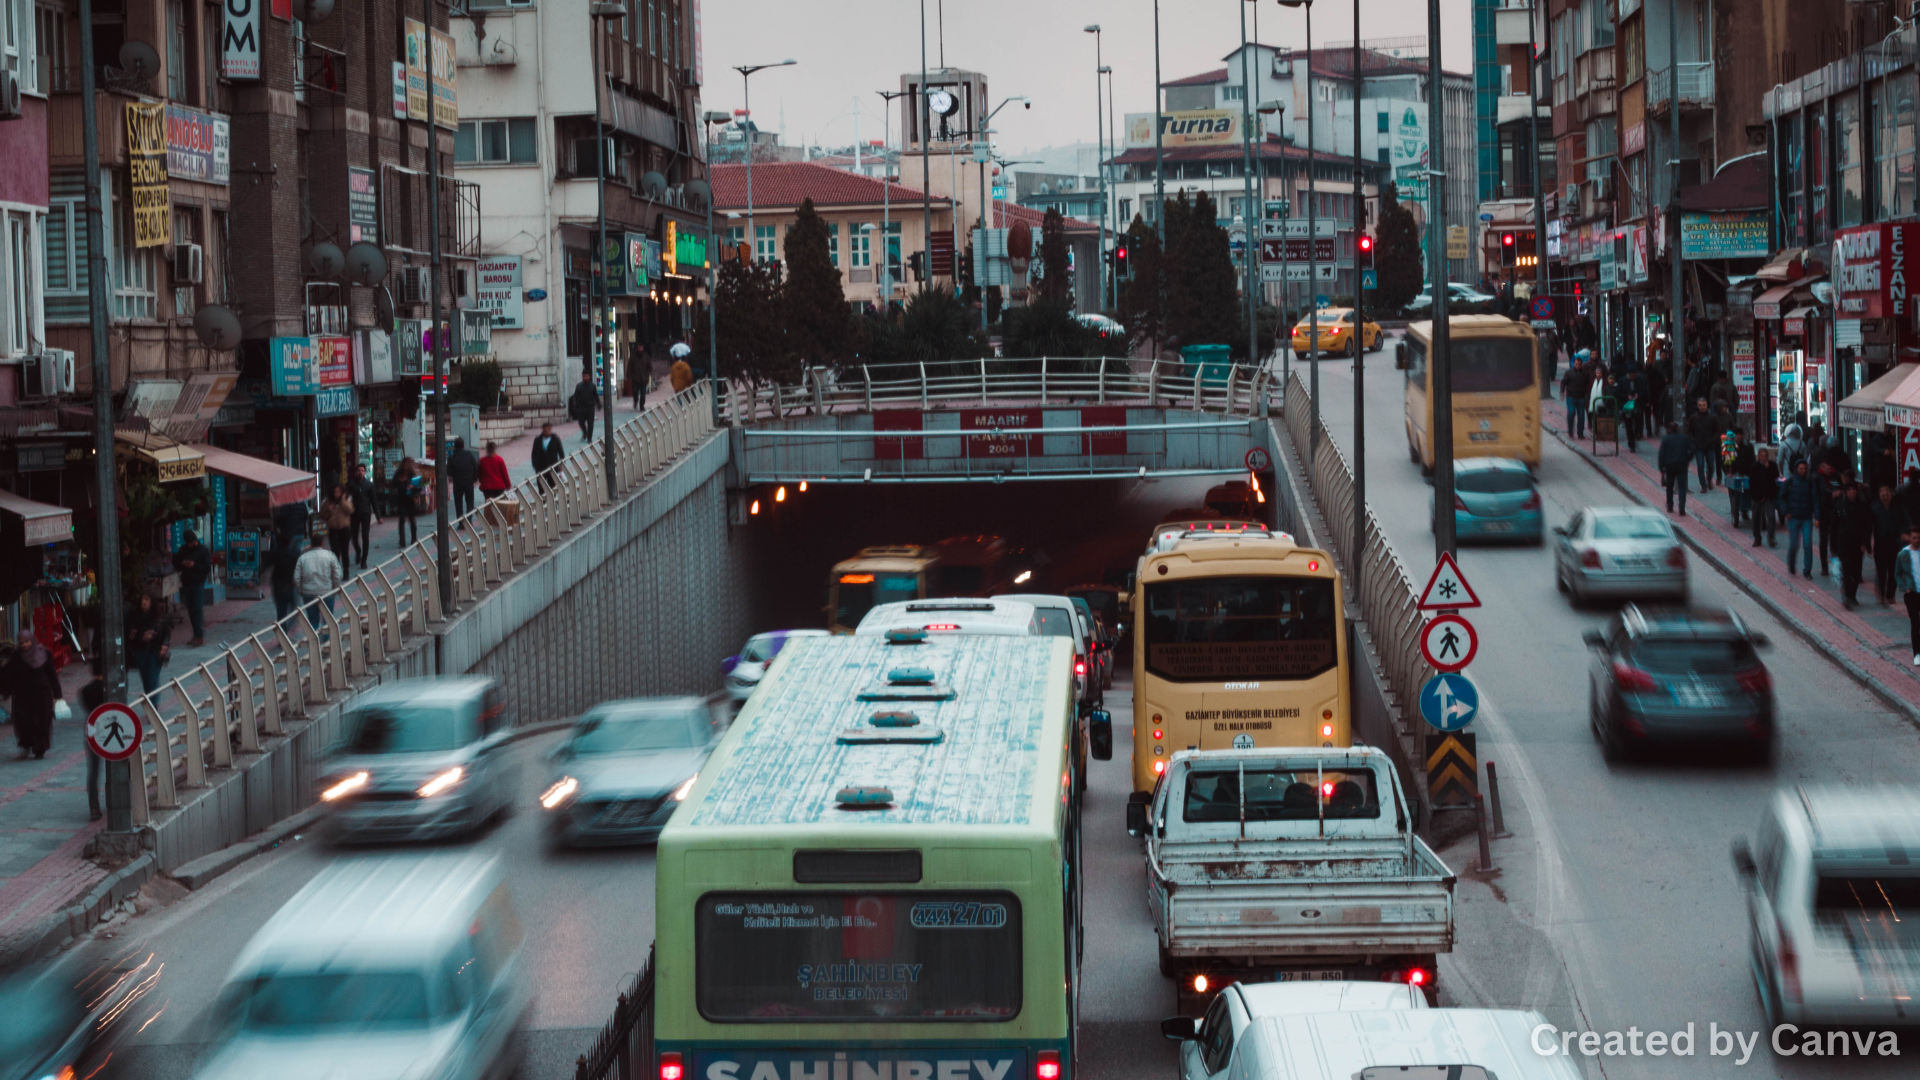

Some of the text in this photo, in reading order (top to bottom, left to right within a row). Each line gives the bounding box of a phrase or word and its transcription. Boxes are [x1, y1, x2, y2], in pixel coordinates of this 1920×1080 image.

[416, 30, 448, 81] TESOY
[1160, 116, 1230, 135] Turna
[1709, 212, 1749, 222] GAP
[1708, 229, 1738, 239] ÜTÜ
[1300, 250, 1333, 259] (Cstle)
[478, 262, 517, 272] GAZİANTEP
[1890, 226, 1906, 315] ECZANE
[483, 275, 512, 283] BAROSU
[974, 412, 1028, 426] MAARİF
[988, 444, 1015, 454] 2004
[159, 459, 199, 479] ÇİÇEKÇİ
[1224, 681, 1260, 690] OTOKAR
[1185, 706, 1300, 720] GAZİANTEP BÜYÜKŞEHİR BELEDİYESİ
[1213, 720, 1272, 731] ÖZEL HALK OTOBÜSÜ
[1241, 735, 1246, 743] 1
[715, 903, 744, 915] Güler
[801, 904, 814, 914] ve
[914, 901, 1002, 925] 444 27 01
[744, 916, 781, 928] Kaliteli
[782, 916, 819, 928] Hizmet
[820, 914, 839, 929] İçin
[841, 916, 852, 927] El
[796, 958, 923, 987] ŞAHİNBEY
[1281, 972, 1294, 981] 27
[814, 984, 907, 1001] BELEDİYESİ
